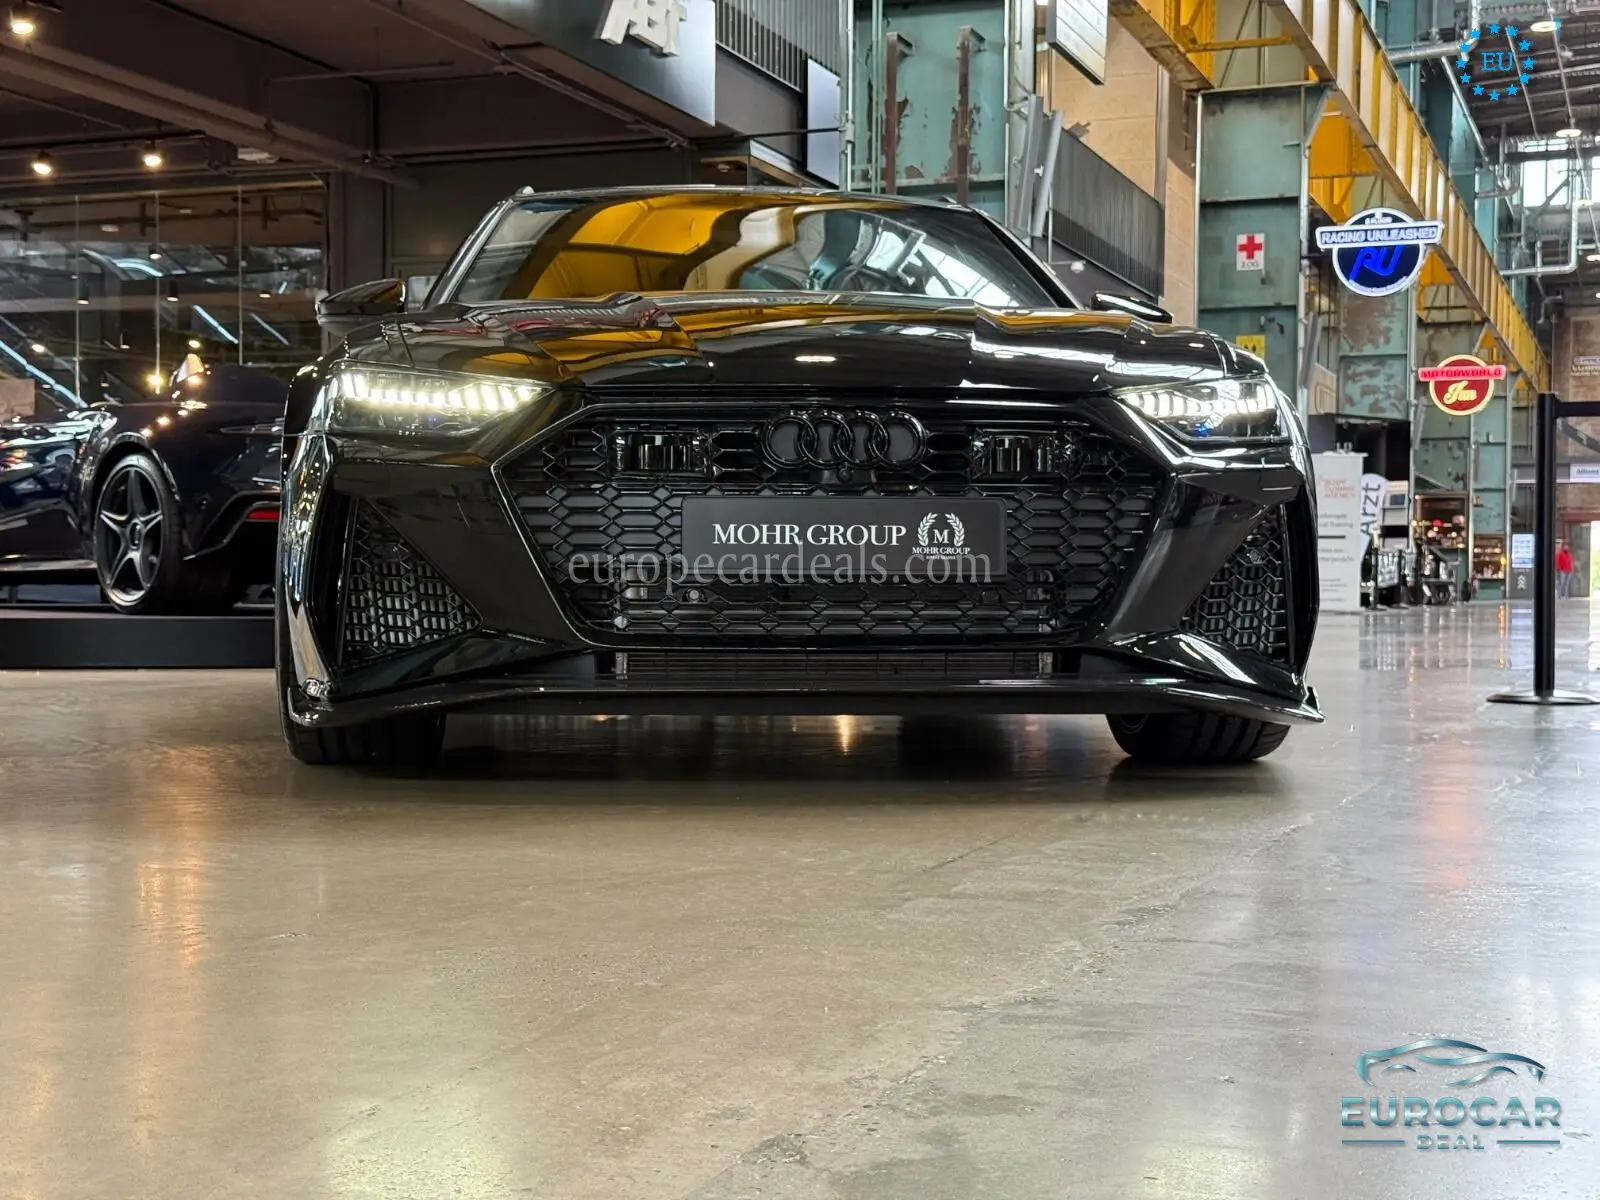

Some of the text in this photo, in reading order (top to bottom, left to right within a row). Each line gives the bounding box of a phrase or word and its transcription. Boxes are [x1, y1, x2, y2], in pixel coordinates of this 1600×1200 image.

[1321, 226, 1437, 244] RACING UNLEASHED
[1421, 367, 1502, 379] MOTORWORLD
[1360, 483, 1382, 536] Arzt
[712, 523, 907, 546] MOHR GROUP
[932, 529, 951, 544] M
